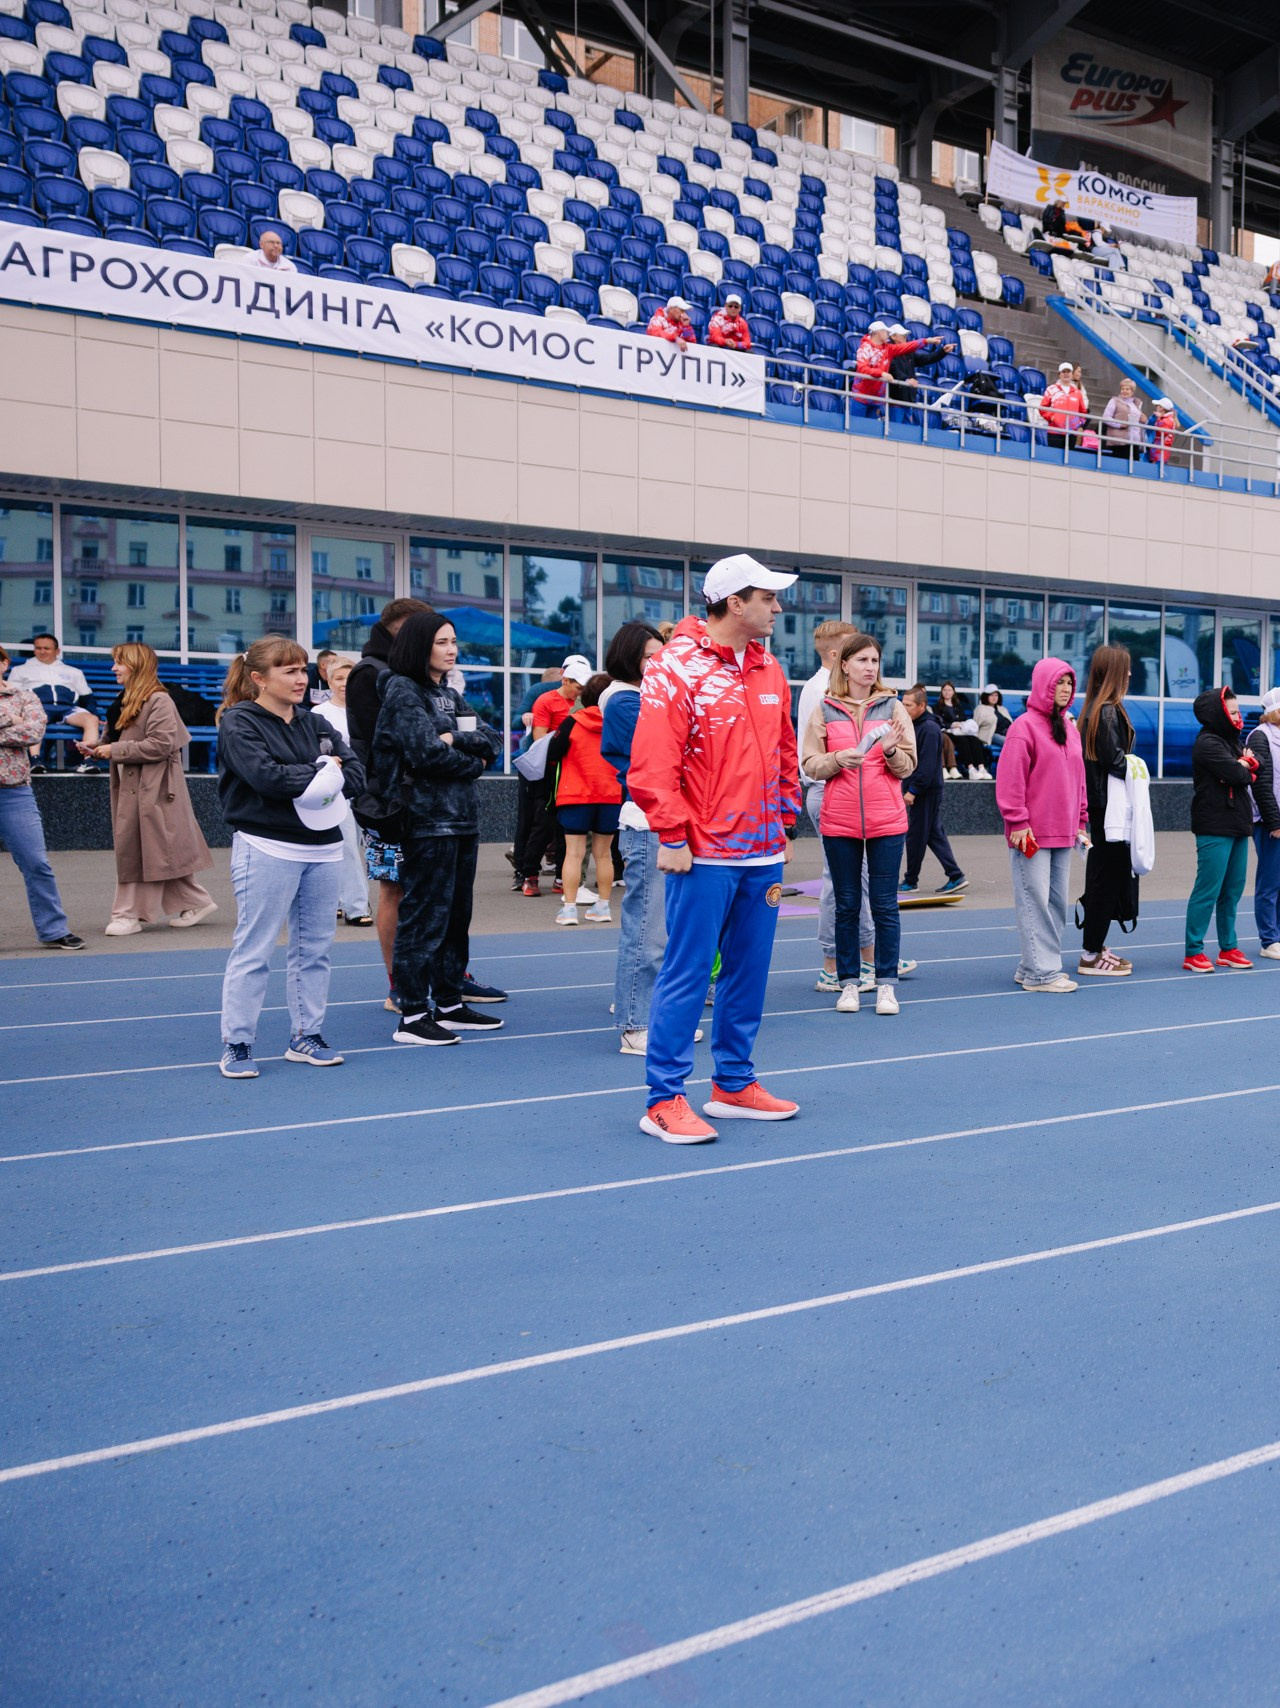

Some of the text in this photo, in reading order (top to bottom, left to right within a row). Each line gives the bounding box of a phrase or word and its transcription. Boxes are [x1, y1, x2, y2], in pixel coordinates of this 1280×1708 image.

[1060, 52, 1167, 96] Europa
[1077, 194, 1141, 219] ВАРАКСИНО
[1078, 174, 1155, 210] КОМОС
[0, 241, 747, 388] АГРОХОЛДИНГА «КОМОС ГРУПП»
[655, 1113, 669, 1131] HOKA
